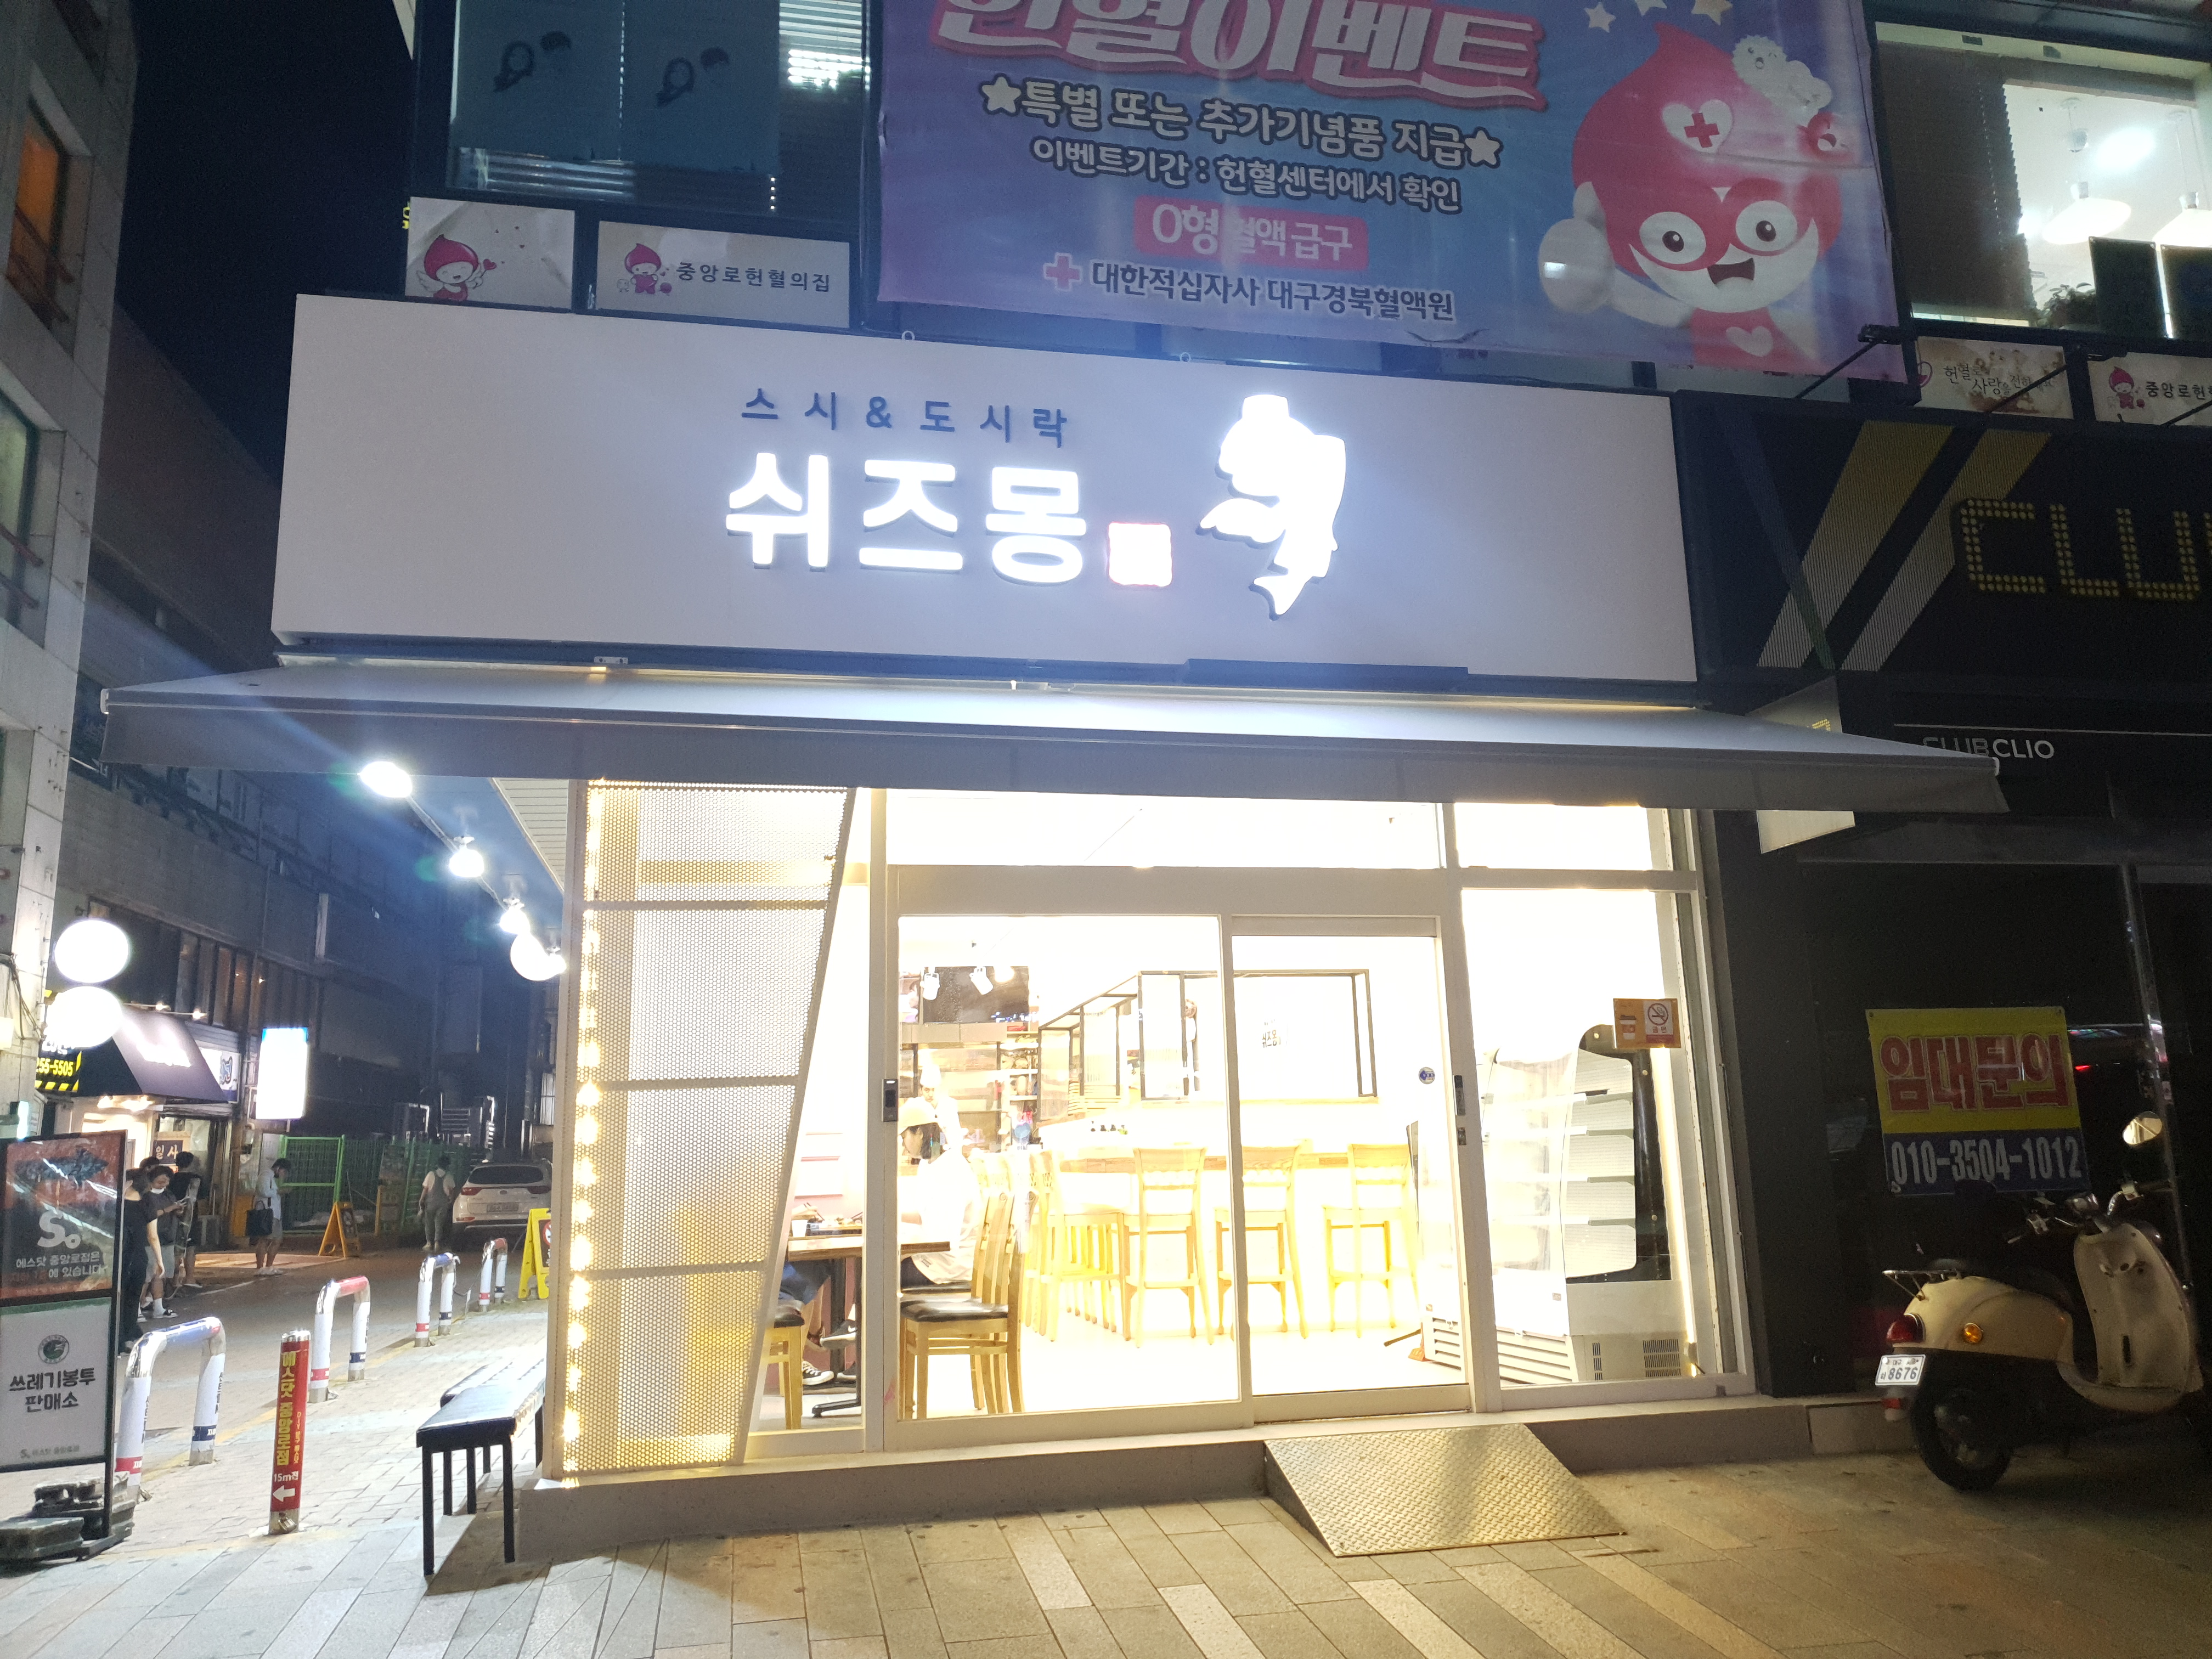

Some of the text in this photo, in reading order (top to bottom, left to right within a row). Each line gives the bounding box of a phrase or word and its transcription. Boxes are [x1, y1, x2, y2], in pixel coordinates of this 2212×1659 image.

[1020, 80, 1465, 167] 특별 또는 추가기념품 지급
[1033, 138, 1190, 186] 이벤트기간
[1216, 157, 1393, 202] 헌혈센터에서
[1401, 175, 1460, 211] 확인
[1291, 222, 1353, 261] 급구
[1092, 260, 1454, 321] 대한적십자사 대구경북혈액원
[725, 452, 1087, 585] 쉬즈몽
[1960, 498, 2212, 601] CLU
[1879, 1032, 2072, 1113] 임대문의
[1891, 1135, 2083, 1185] 010-3504-1012
[9, 1367, 96, 1392] 쓰레기봉투
[25, 1391, 79, 1413] 판매소
[1888, 1367, 1918, 1380] 8676
